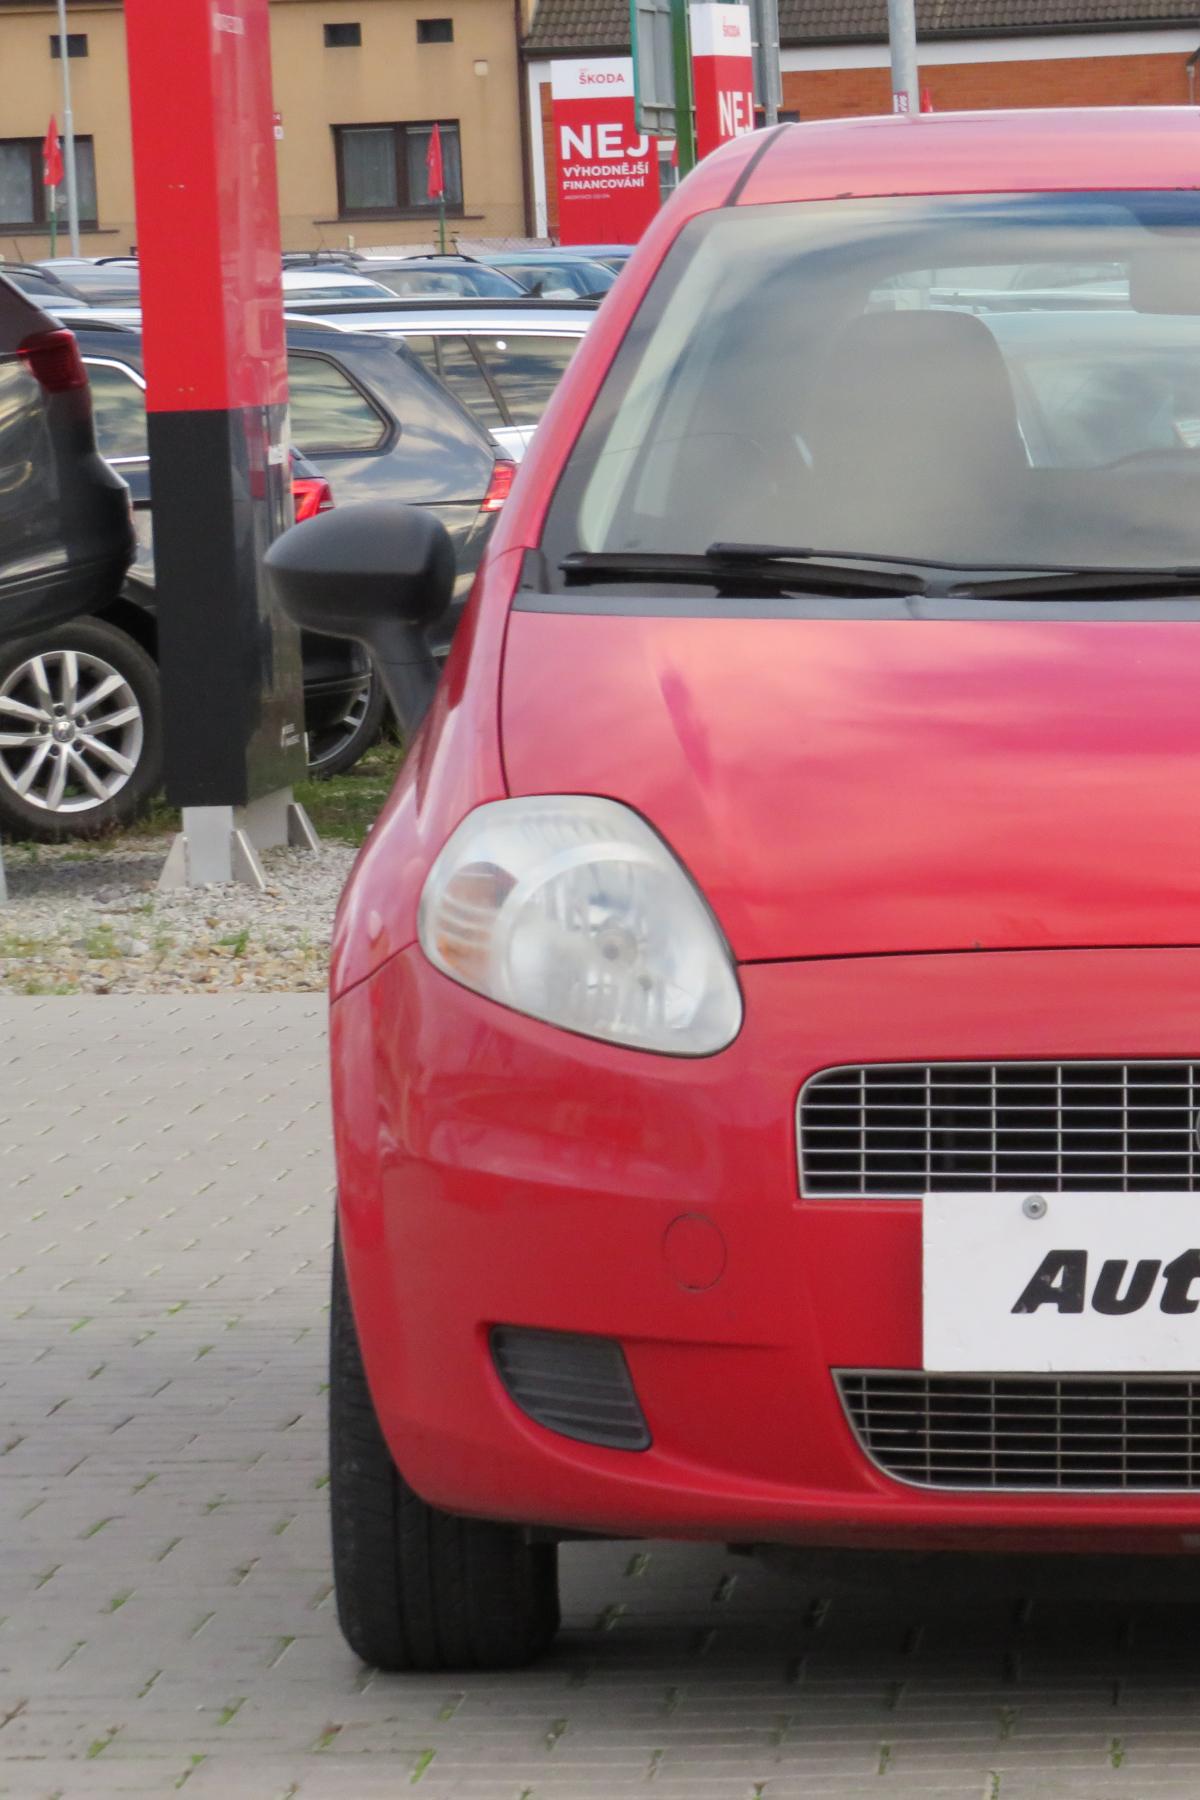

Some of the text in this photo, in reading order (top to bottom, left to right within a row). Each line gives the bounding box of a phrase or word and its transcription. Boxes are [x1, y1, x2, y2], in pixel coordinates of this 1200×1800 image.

[579, 72, 625, 85] ŠKODA
[718, 90, 753, 137] NEJ
[560, 123, 650, 160] NEJ
[563, 161, 649, 178] VÝHODNĚJŠÍ
[563, 176, 645, 191] FINANCOVÁNÍ
